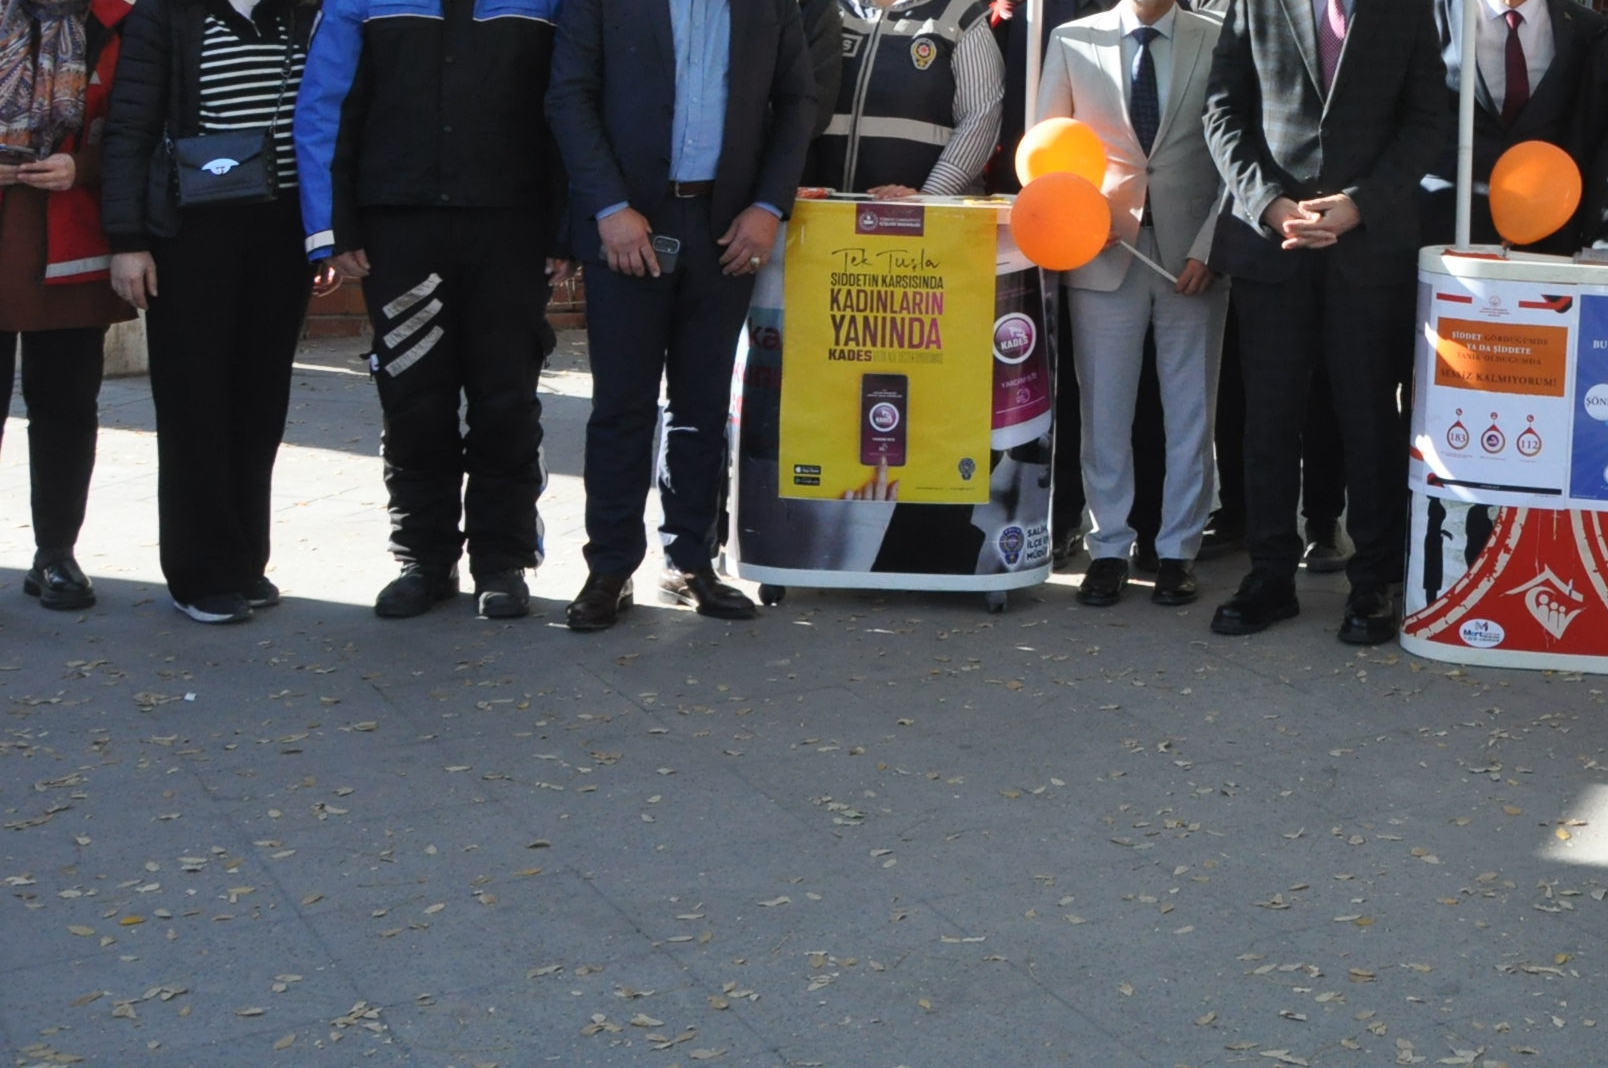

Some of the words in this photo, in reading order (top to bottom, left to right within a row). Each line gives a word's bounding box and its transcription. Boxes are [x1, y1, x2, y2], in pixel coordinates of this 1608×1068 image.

[832, 247, 873, 272] Tek
[876, 248, 941, 273] Tuşla
[830, 288, 944, 316] KADINLARIN
[830, 314, 942, 350] YANINDA
[1452, 330, 1481, 340] ŞİDDET
[1001, 336, 1028, 350] KADES
[1467, 343, 1476, 351] YA
[1493, 344, 1532, 355] ŞİDDETE
[1593, 340, 1607, 349] BU
[829, 349, 872, 362] KADES
[1476, 371, 1557, 387] KALMIYORUM!
[1450, 433, 1466, 443] 183
[1521, 440, 1538, 450] 112
